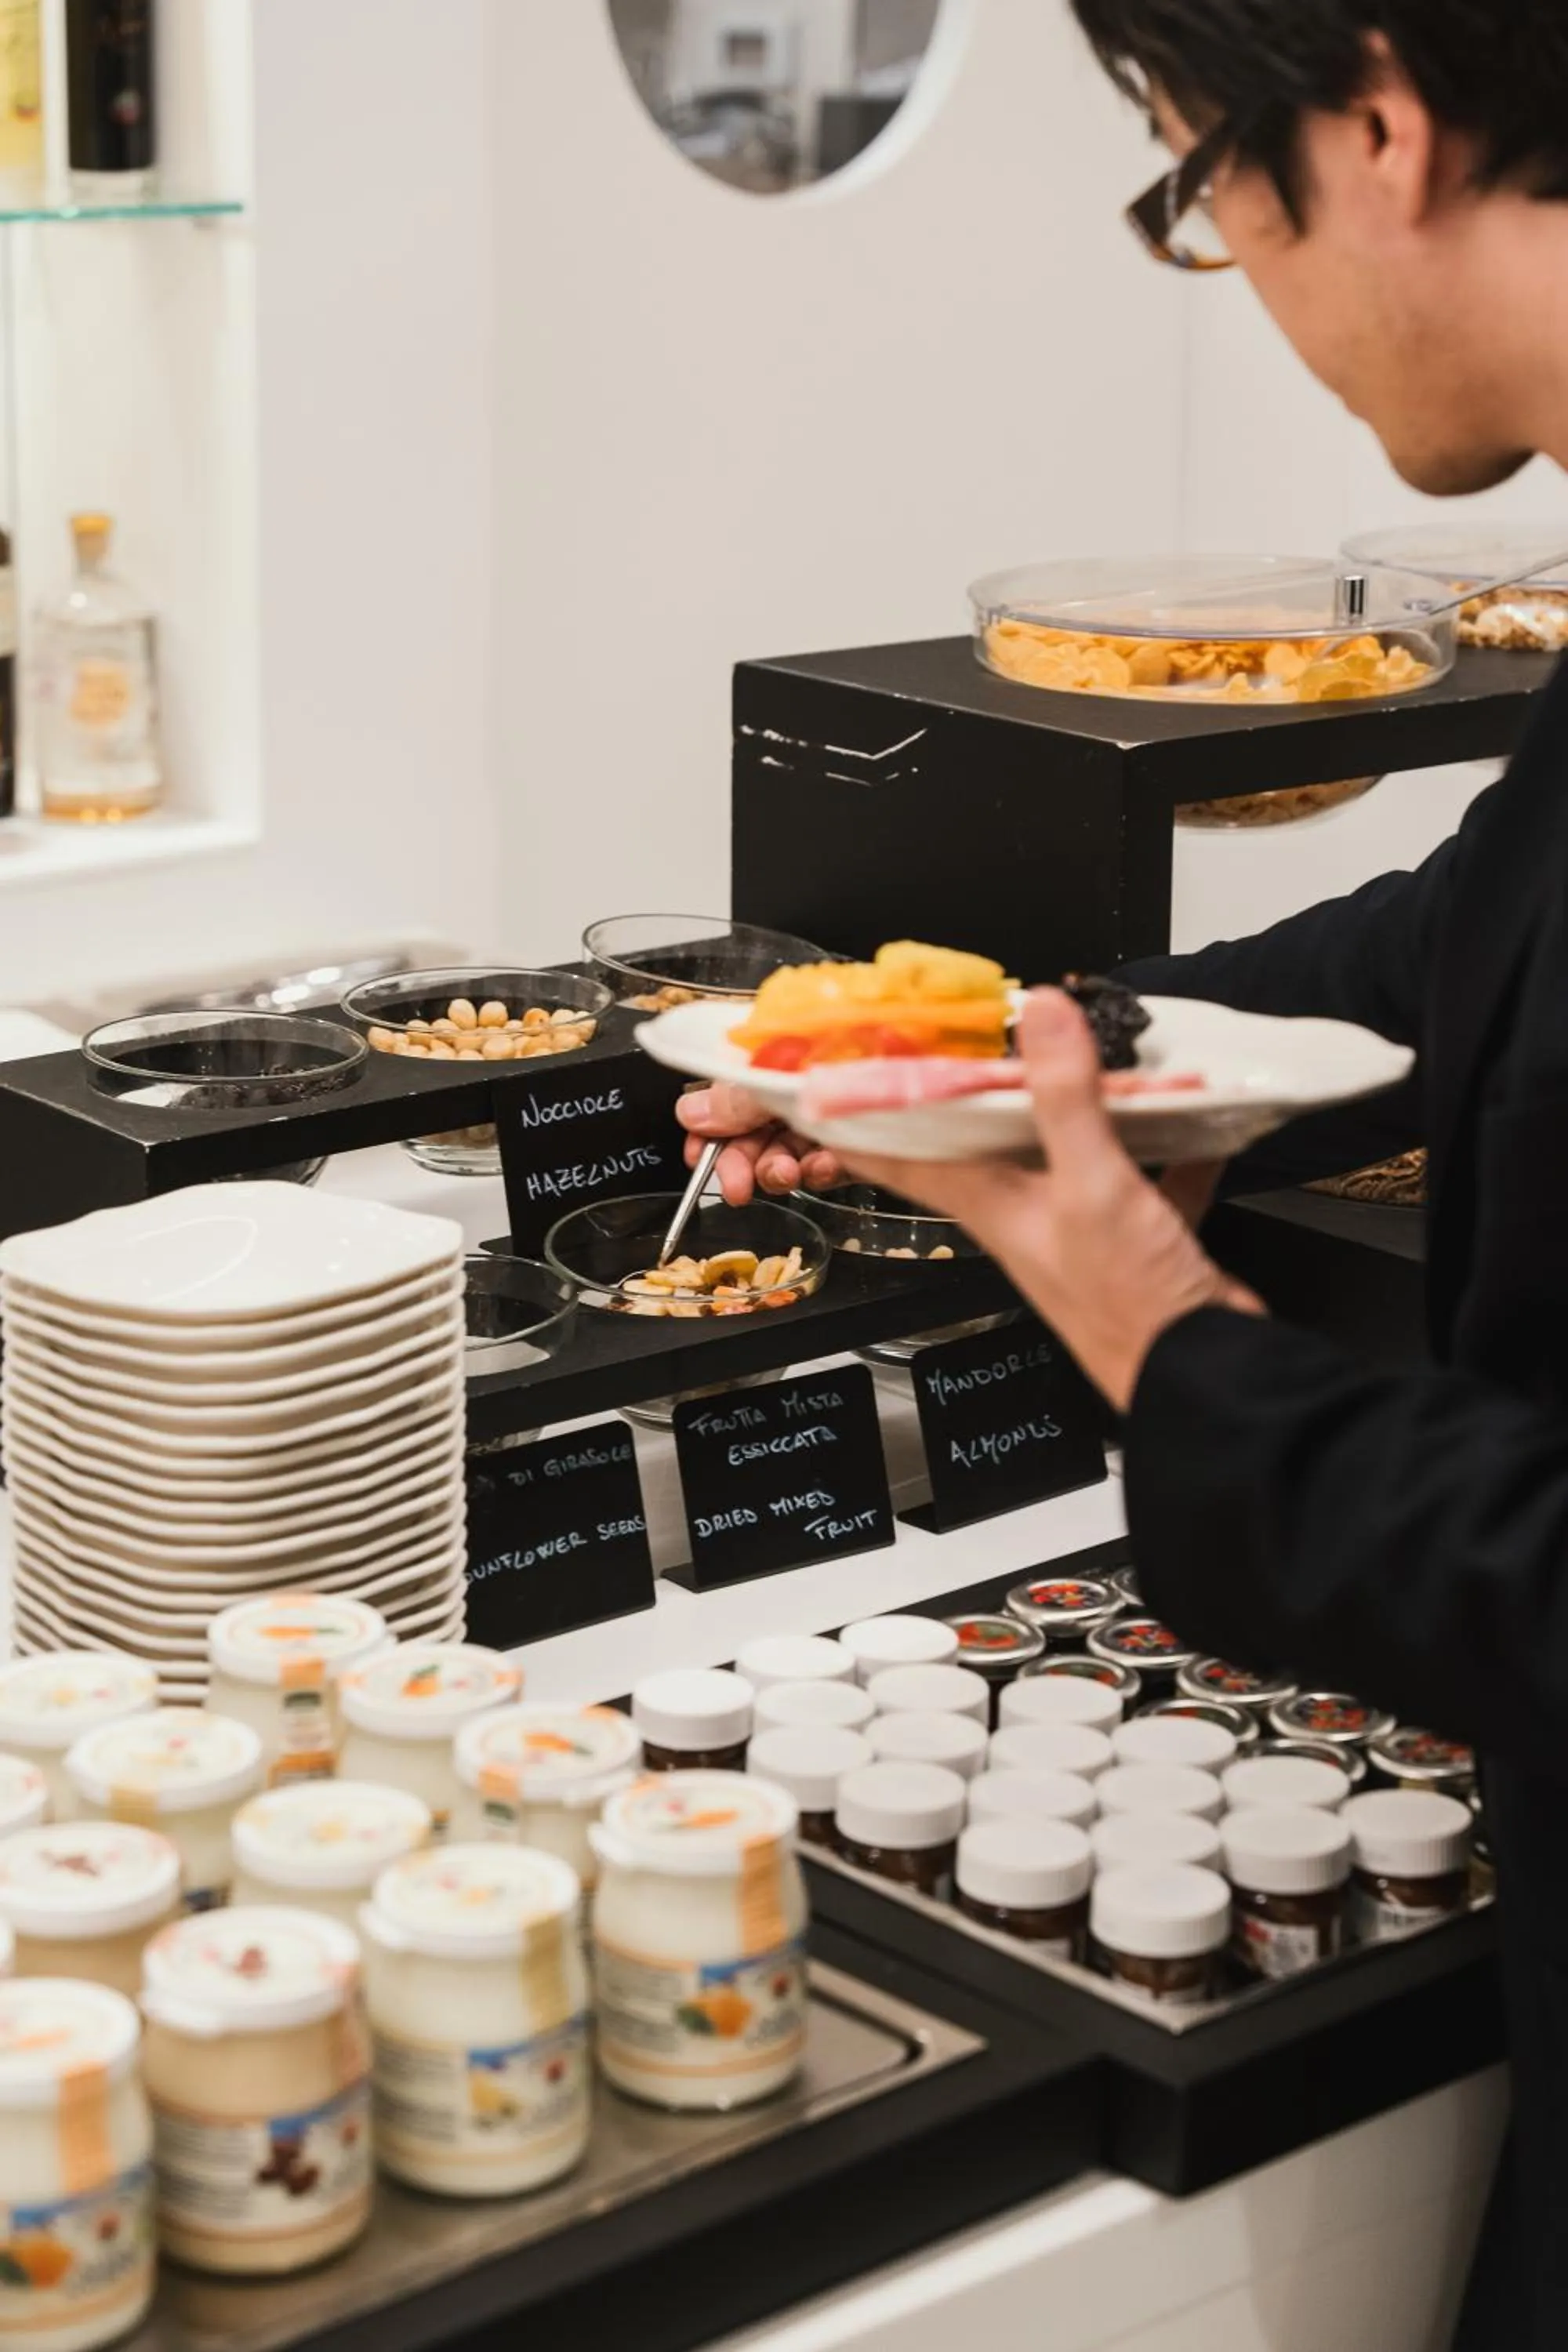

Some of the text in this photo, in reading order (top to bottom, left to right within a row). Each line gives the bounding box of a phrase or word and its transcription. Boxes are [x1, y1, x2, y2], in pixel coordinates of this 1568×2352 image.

[521, 1088, 623, 1128] NOCCIOLE
[526, 1145, 662, 1200] HAZELNUTS
[925, 1343, 1053, 1406] MANDORLE
[685, 1406, 768, 1436] FRUTTA
[506, 1444, 633, 1486] DI GIRASOLE
[728, 1425, 838, 1466] ESSICCATA
[597, 1515, 646, 1541] SEEDS
[694, 1490, 836, 1538] DRIED MIXED
[804, 1508, 878, 1541] FRUIT
